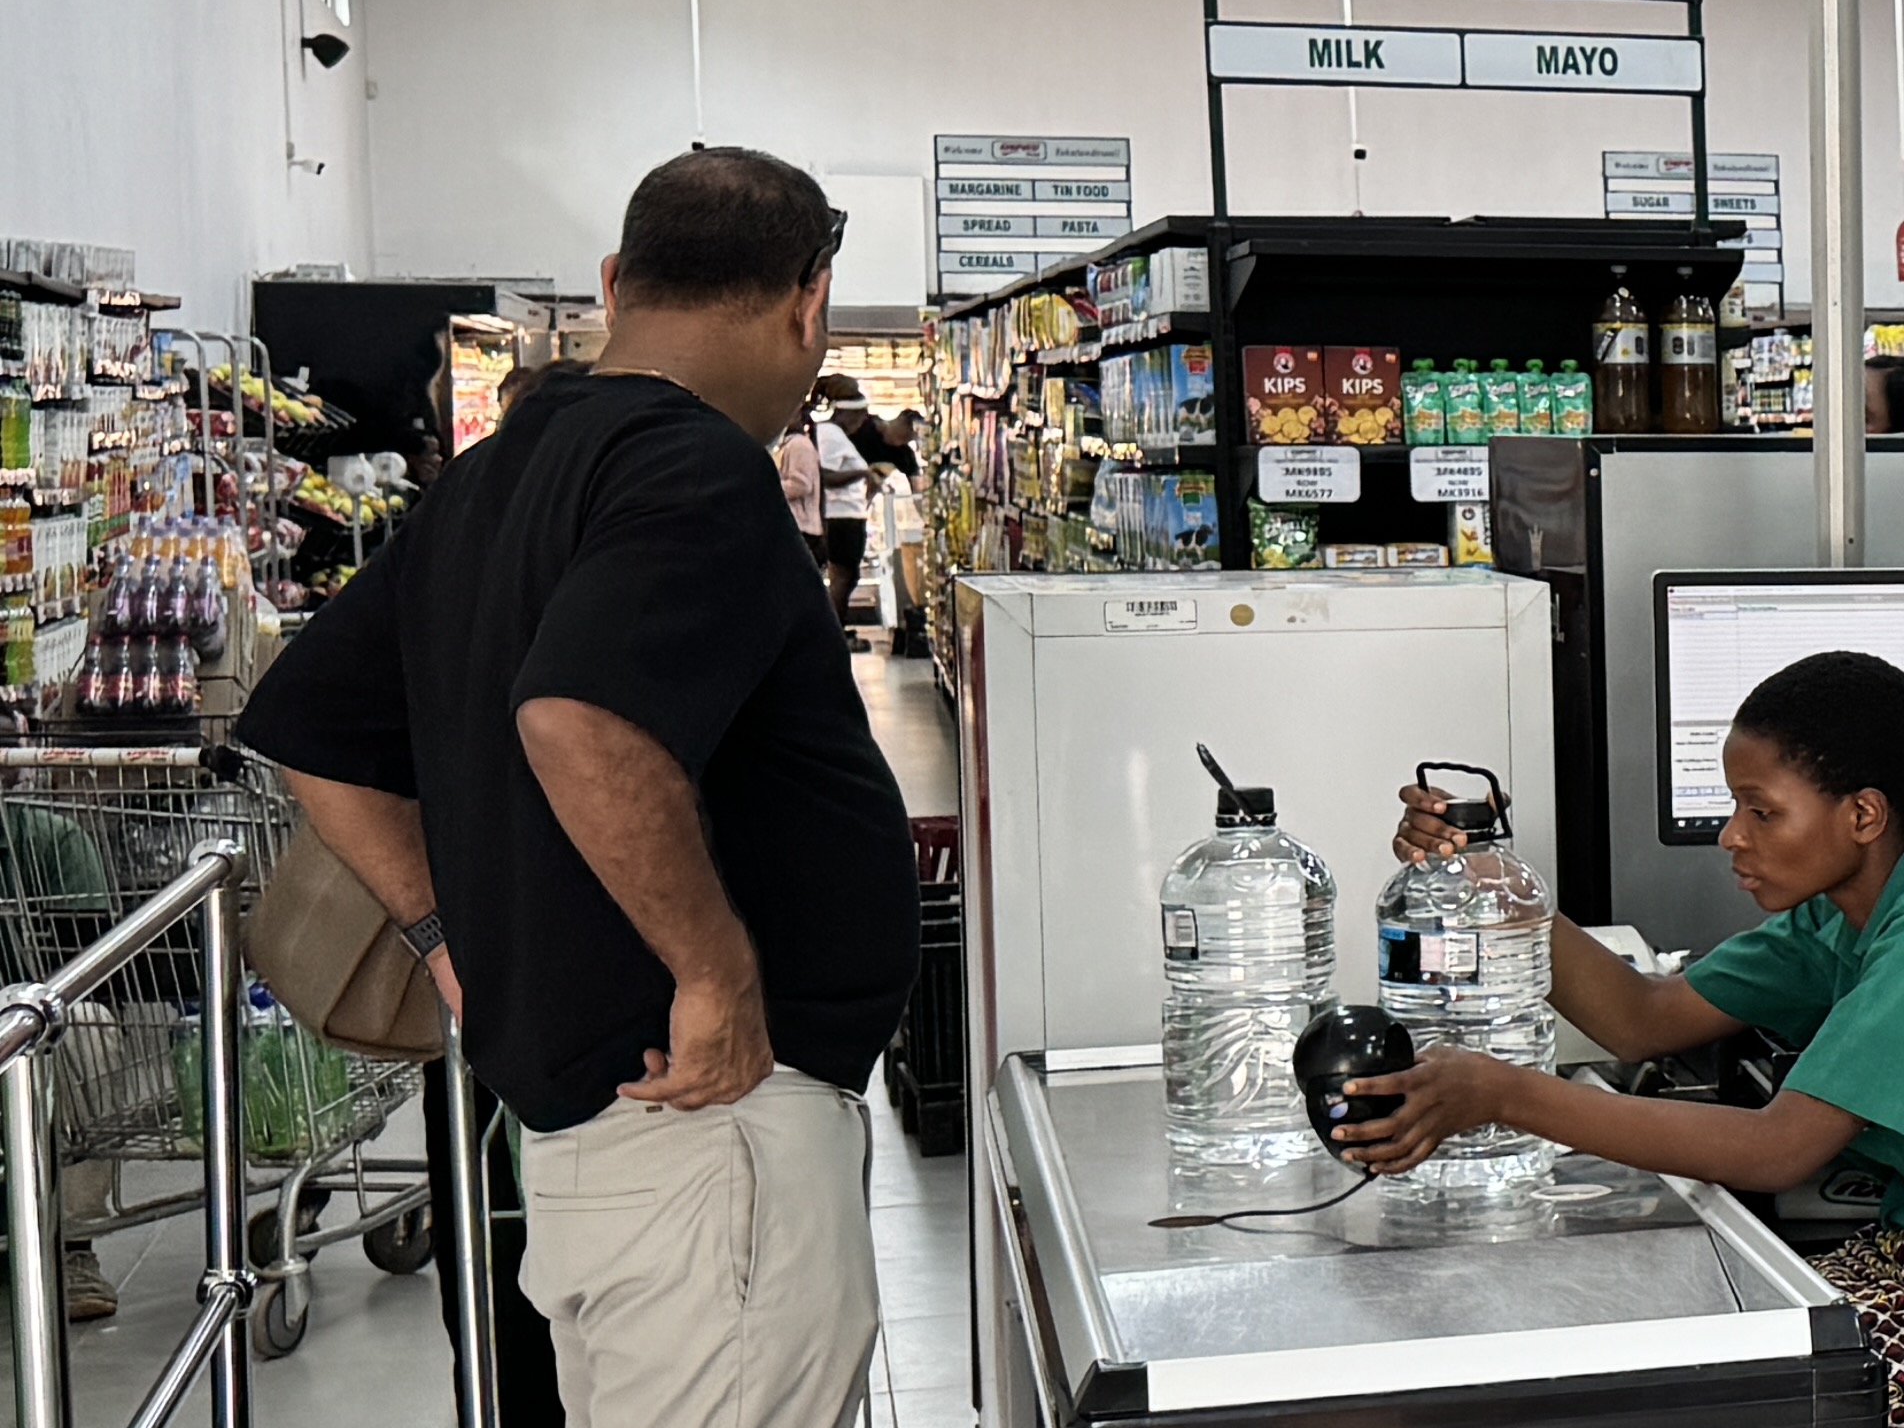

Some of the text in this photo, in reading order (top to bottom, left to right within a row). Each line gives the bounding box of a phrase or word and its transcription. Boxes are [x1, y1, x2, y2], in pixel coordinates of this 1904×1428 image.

[1308, 38, 1385, 69] MILK
[1536, 45, 1618, 77] MAYO
[949, 183, 1022, 196] MARGARINE
[1052, 185, 1109, 197] TIN FOOD
[1632, 196, 1669, 207] SUGAR
[1713, 198, 1756, 210] SWEETS
[963, 220, 1011, 232] SPREAD
[1062, 221, 1099, 233] PASTA
[959, 256, 1014, 268] CEREALS
[1264, 377, 1306, 394] KIPS
[1342, 378, 1384, 395] KIPS
